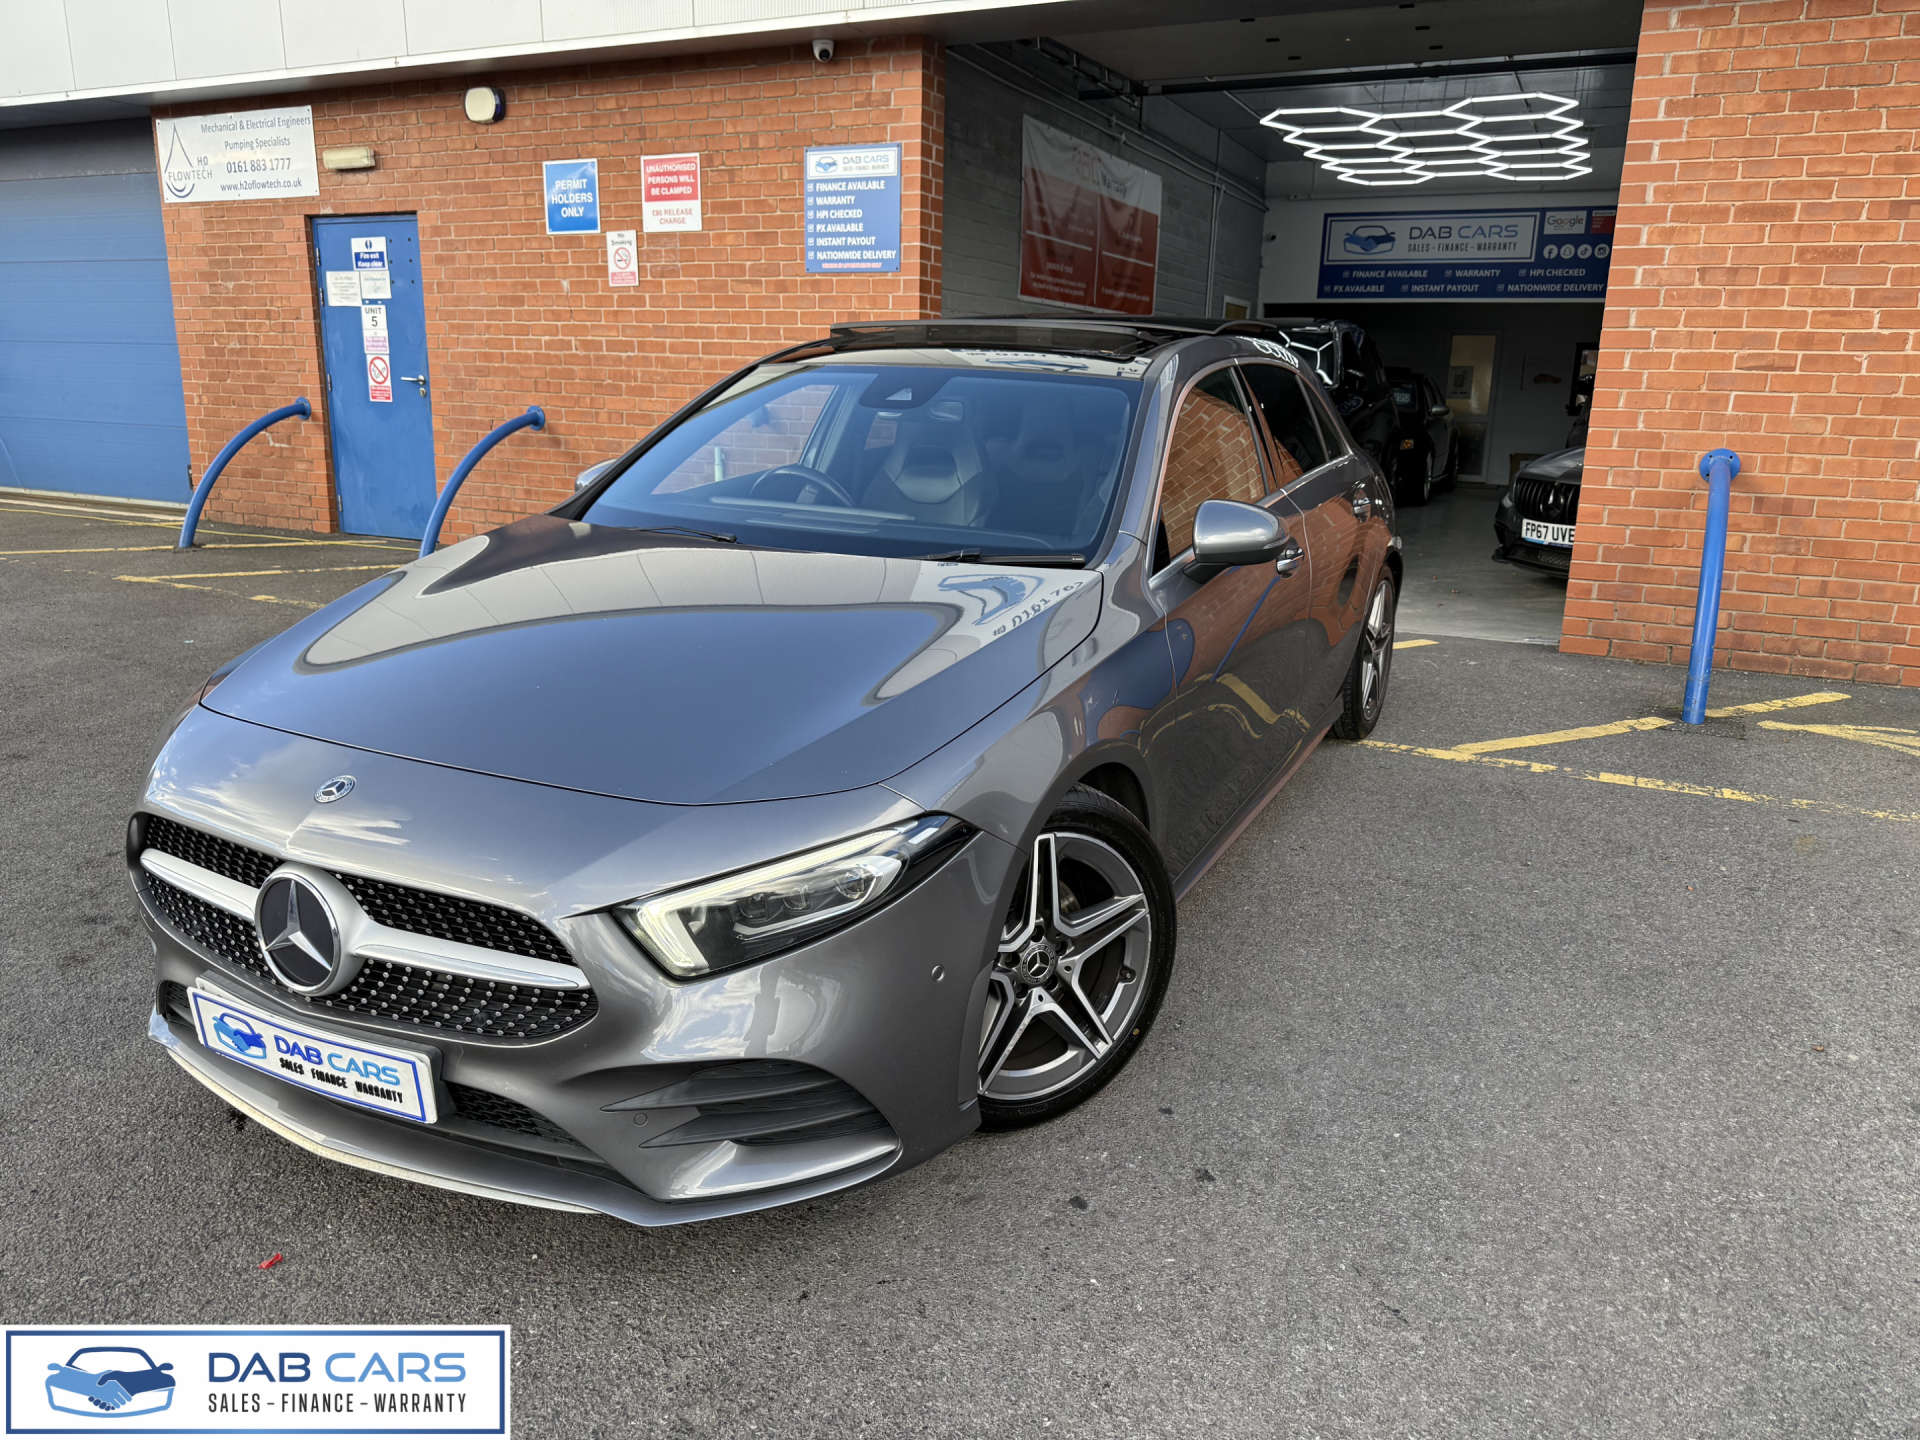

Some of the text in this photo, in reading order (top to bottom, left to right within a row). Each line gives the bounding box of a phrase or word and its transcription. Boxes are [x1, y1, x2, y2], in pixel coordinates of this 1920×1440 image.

[201, 115, 311, 134] Mechanical & Electrical Engineers
[224, 136, 291, 151] Pumping Specialists
[843, 154, 889, 165] DAB CARS
[226, 158, 291, 174] 0161 883 1777
[646, 162, 697, 173] UNAUTHORISED
[168, 169, 213, 183] FLOWTECH
[647, 174, 696, 184] PERSONS WILL
[220, 177, 302, 191] www.h2oflowtech.co.uk
[555, 178, 588, 190] PERMIT
[816, 180, 886, 192] FINANCE AVAILABLE
[650, 185, 693, 196] BE CLAMPED
[551, 192, 594, 204] HOLDERS
[816, 196, 855, 205] WARRANTY
[561, 206, 585, 218] ONLY
[664, 208, 693, 216] RELEASE
[816, 209, 863, 219] HPI CHECKED
[1546, 215, 1584, 227] Google
[816, 222, 864, 233] PX AVAILABLE
[1409, 224, 1519, 240] DAB CARS
[816, 236, 876, 246] INSTANT PAYOUT
[1408, 242, 1517, 253] SALES FINANCE WARRANTY
[816, 249, 897, 260] NATIONWIDE DELIVERY
[1352, 268, 1586, 278] FINANCE AVAILABLE WARRANTY HPI CHECKED
[1344, 284, 1385, 293] AVAILABLE
[1410, 284, 1445, 293] INSTANT
[1446, 284, 1480, 293] PAYOUT
[1507, 284, 1561, 293] NATIONWIDE
[1562, 284, 1604, 292] DELIVERY
[371, 316, 378, 327] 5
[1525, 522, 1576, 543] FP67 UVE
[274, 1035, 400, 1086] DAB CARS
[279, 1057, 403, 1104] SALES FINANCE WARRANTY
